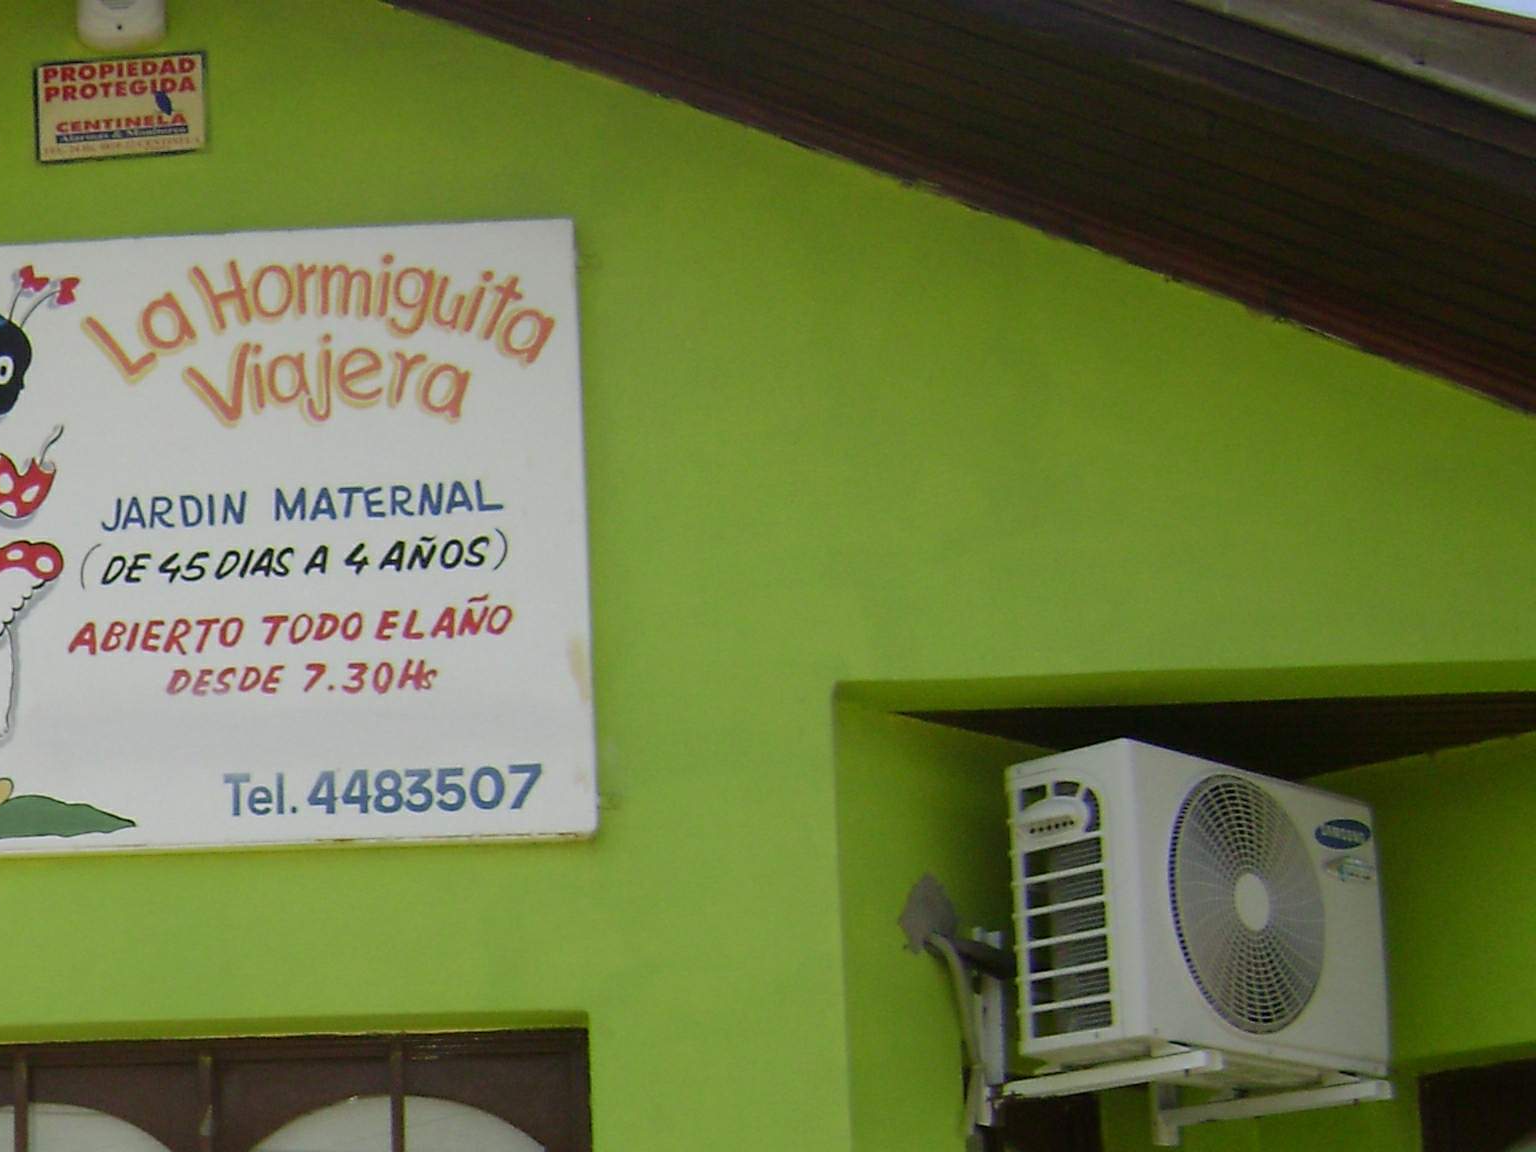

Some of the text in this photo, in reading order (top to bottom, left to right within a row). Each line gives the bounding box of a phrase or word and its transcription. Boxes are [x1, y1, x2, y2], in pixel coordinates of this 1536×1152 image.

[42, 57, 197, 84] PROPIEDAD
[44, 75, 197, 103] PROTEGIDA
[55, 112, 188, 133] CENTINELA
[81, 251, 556, 383] La Hormiguita
[182, 333, 472, 428] Viajera
[101, 479, 504, 532] JARDIN MATERNAL
[80, 527, 509, 589] (DE 45 DIAS A 4 AÑOS)
[68, 616, 244, 655] ABIERTO
[262, 611, 363, 646] TODO
[166, 663, 286, 696] DESDE
[222, 763, 543, 817] Tel. 4483507
